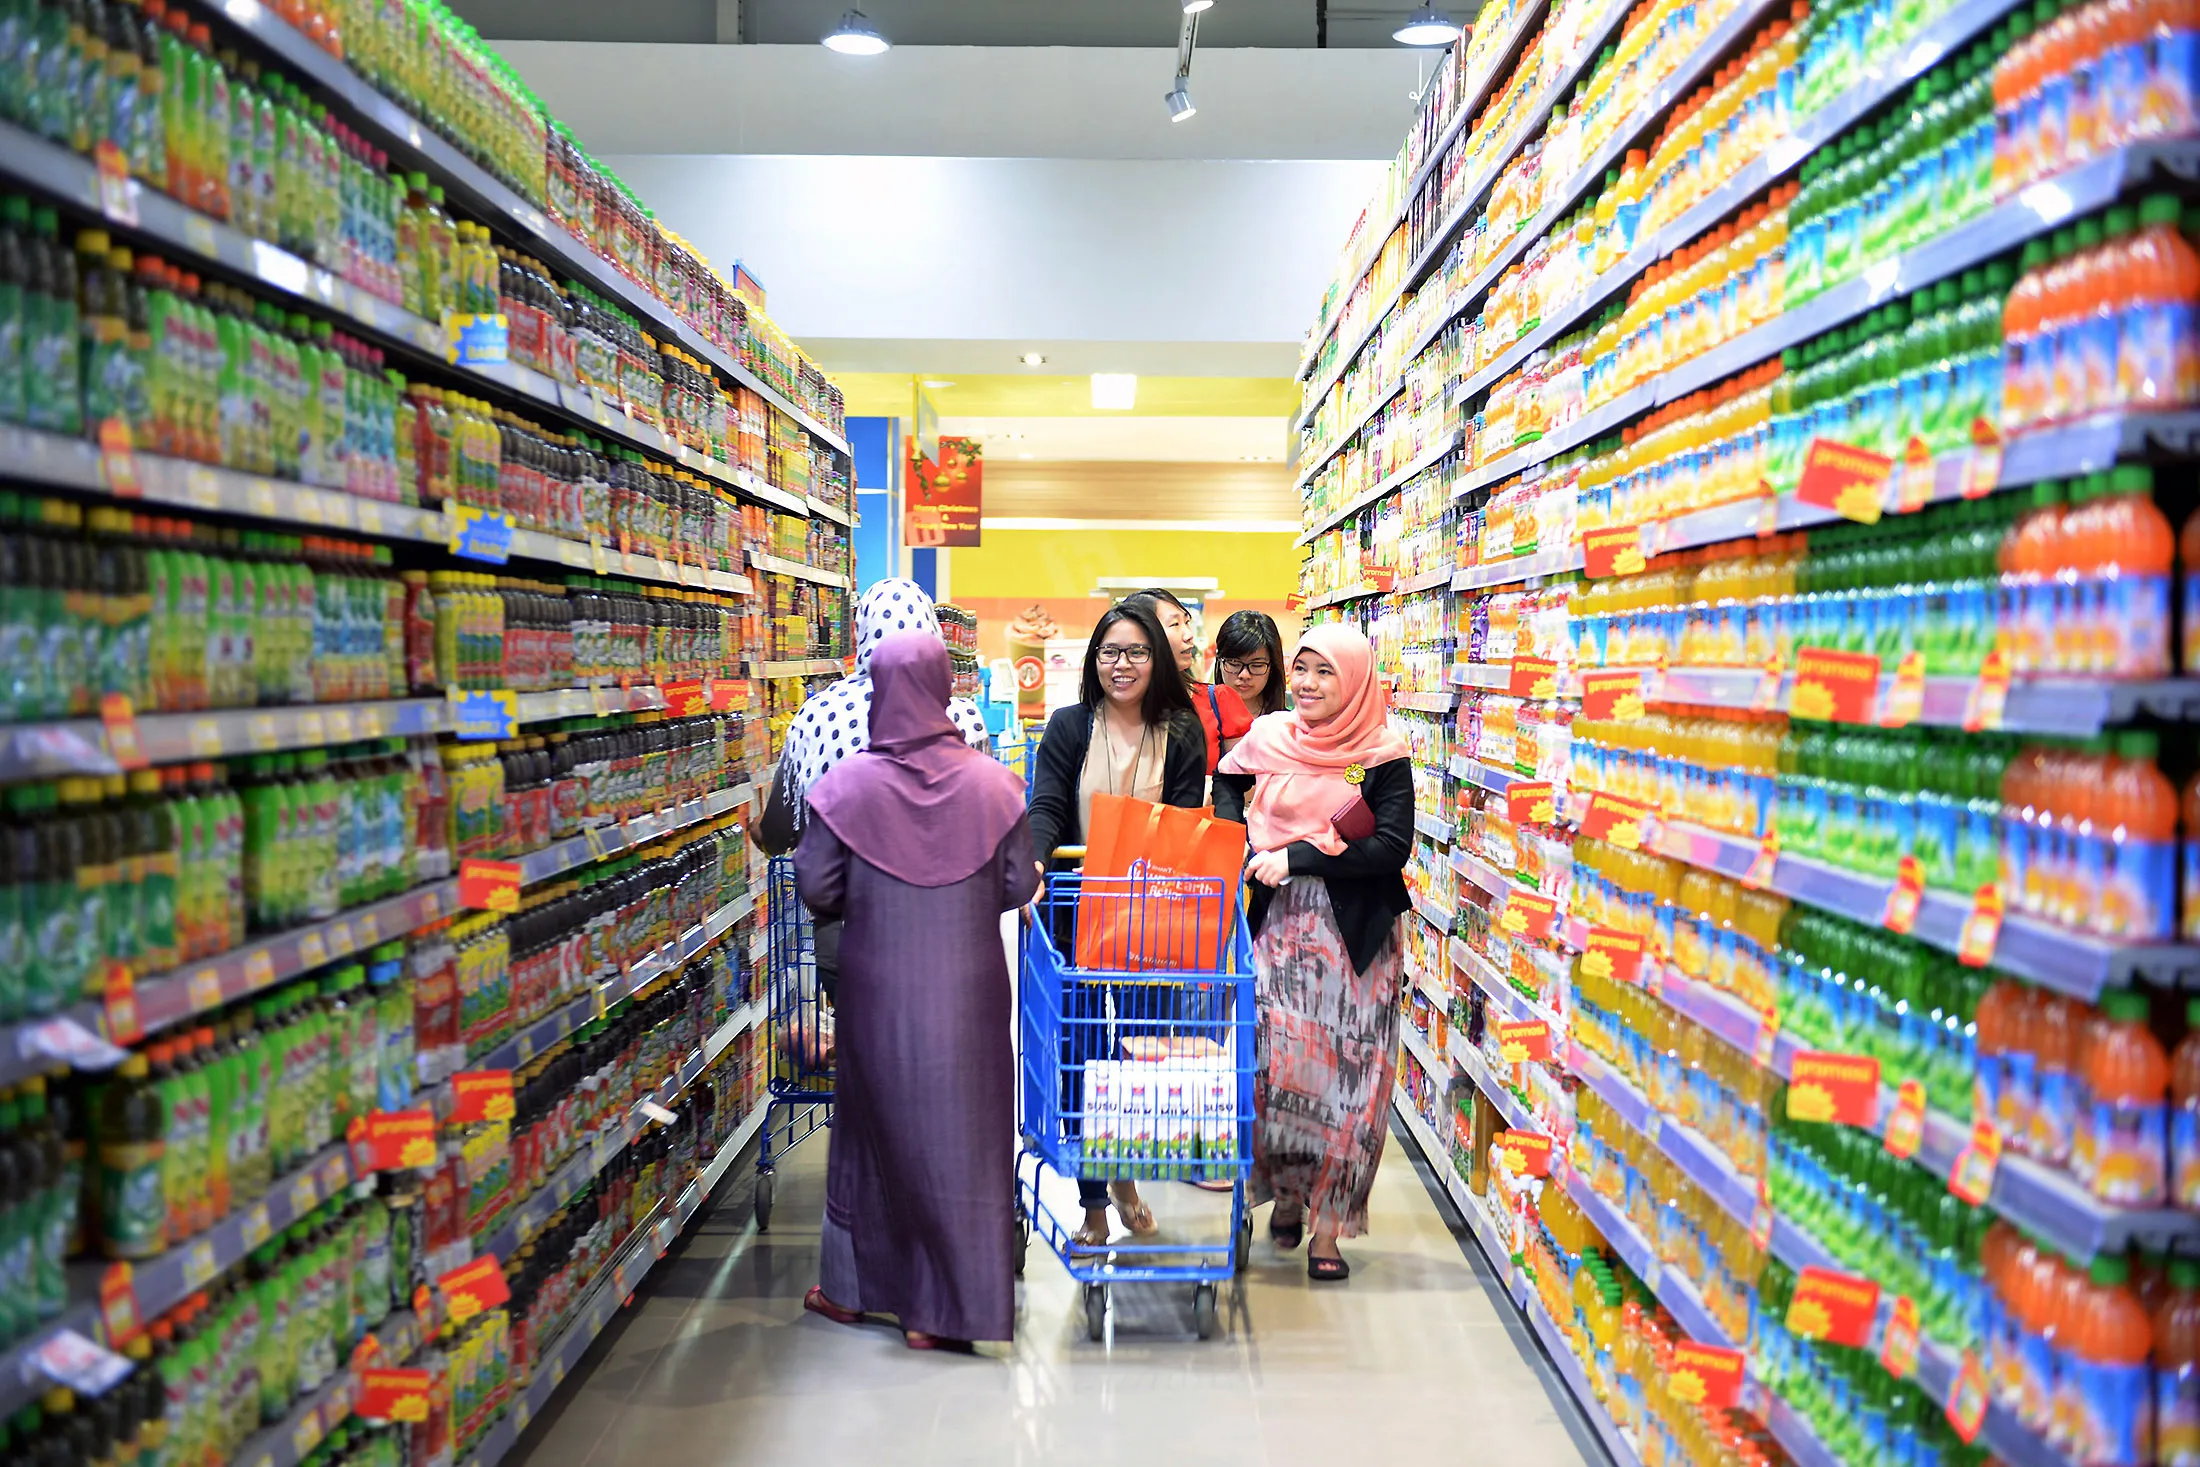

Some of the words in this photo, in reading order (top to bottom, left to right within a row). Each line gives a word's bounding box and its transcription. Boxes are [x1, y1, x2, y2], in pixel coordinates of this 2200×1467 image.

[938, 504, 979, 513] Christmas
[1363, 569, 1392, 578] promosi
[1508, 895, 1552, 913] promosi
[1501, 1025, 1546, 1040] promosi
[1505, 1133, 1550, 1150] promosi
